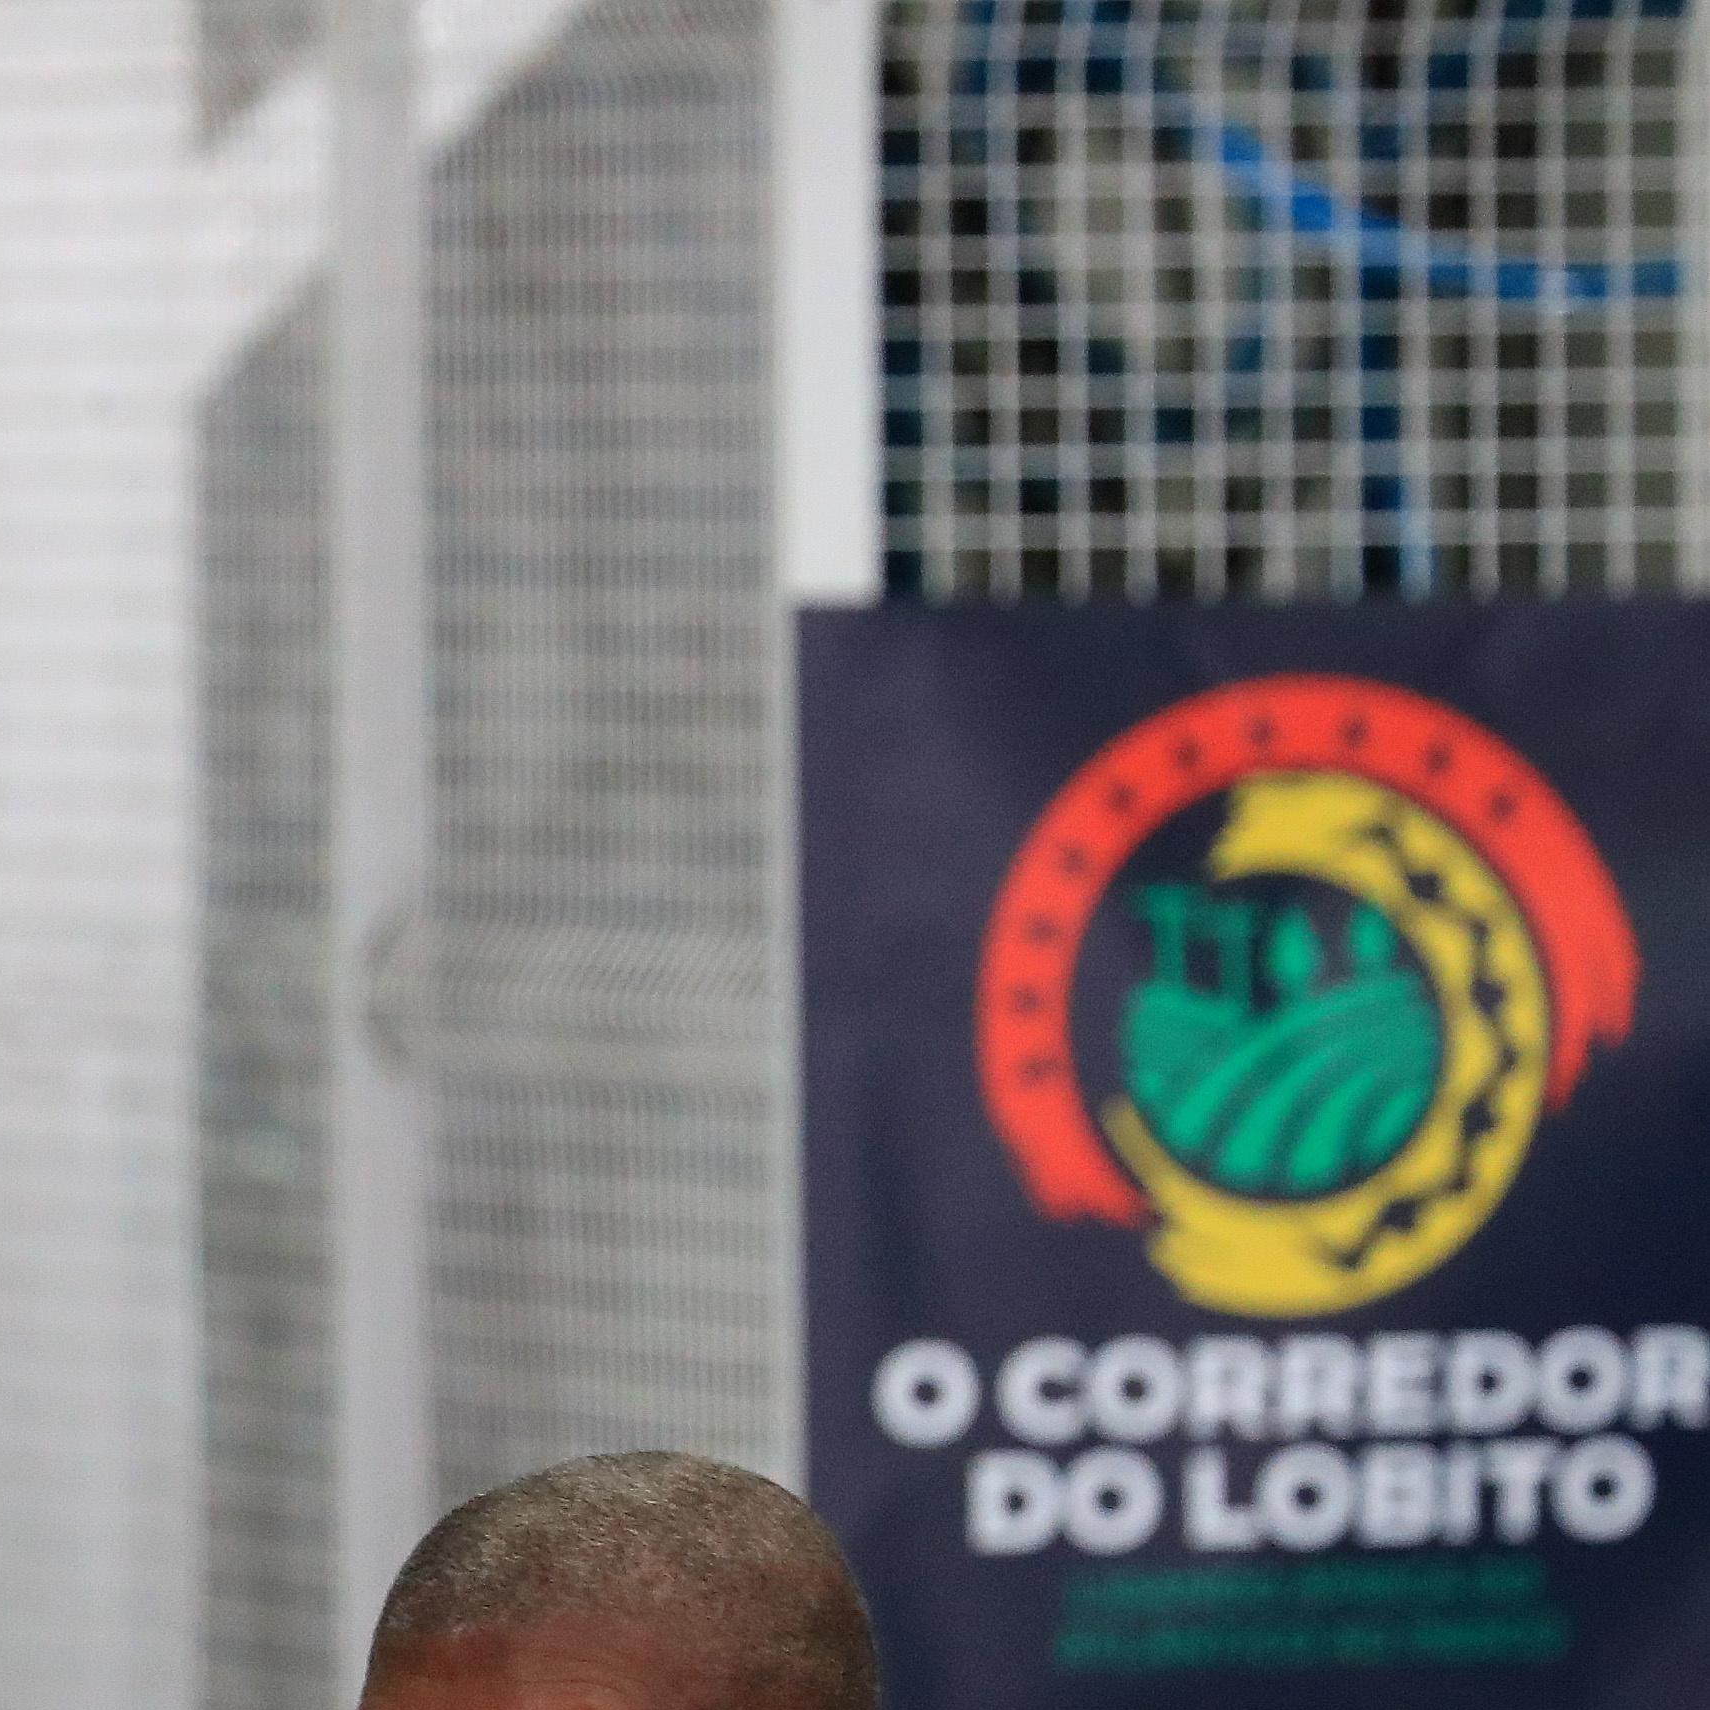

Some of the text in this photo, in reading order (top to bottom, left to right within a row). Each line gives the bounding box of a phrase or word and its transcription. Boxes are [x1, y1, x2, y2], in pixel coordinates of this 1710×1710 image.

[872, 1323, 1710, 1448] O CORREDOR
[967, 1432, 1657, 1555] DO LOBITO
